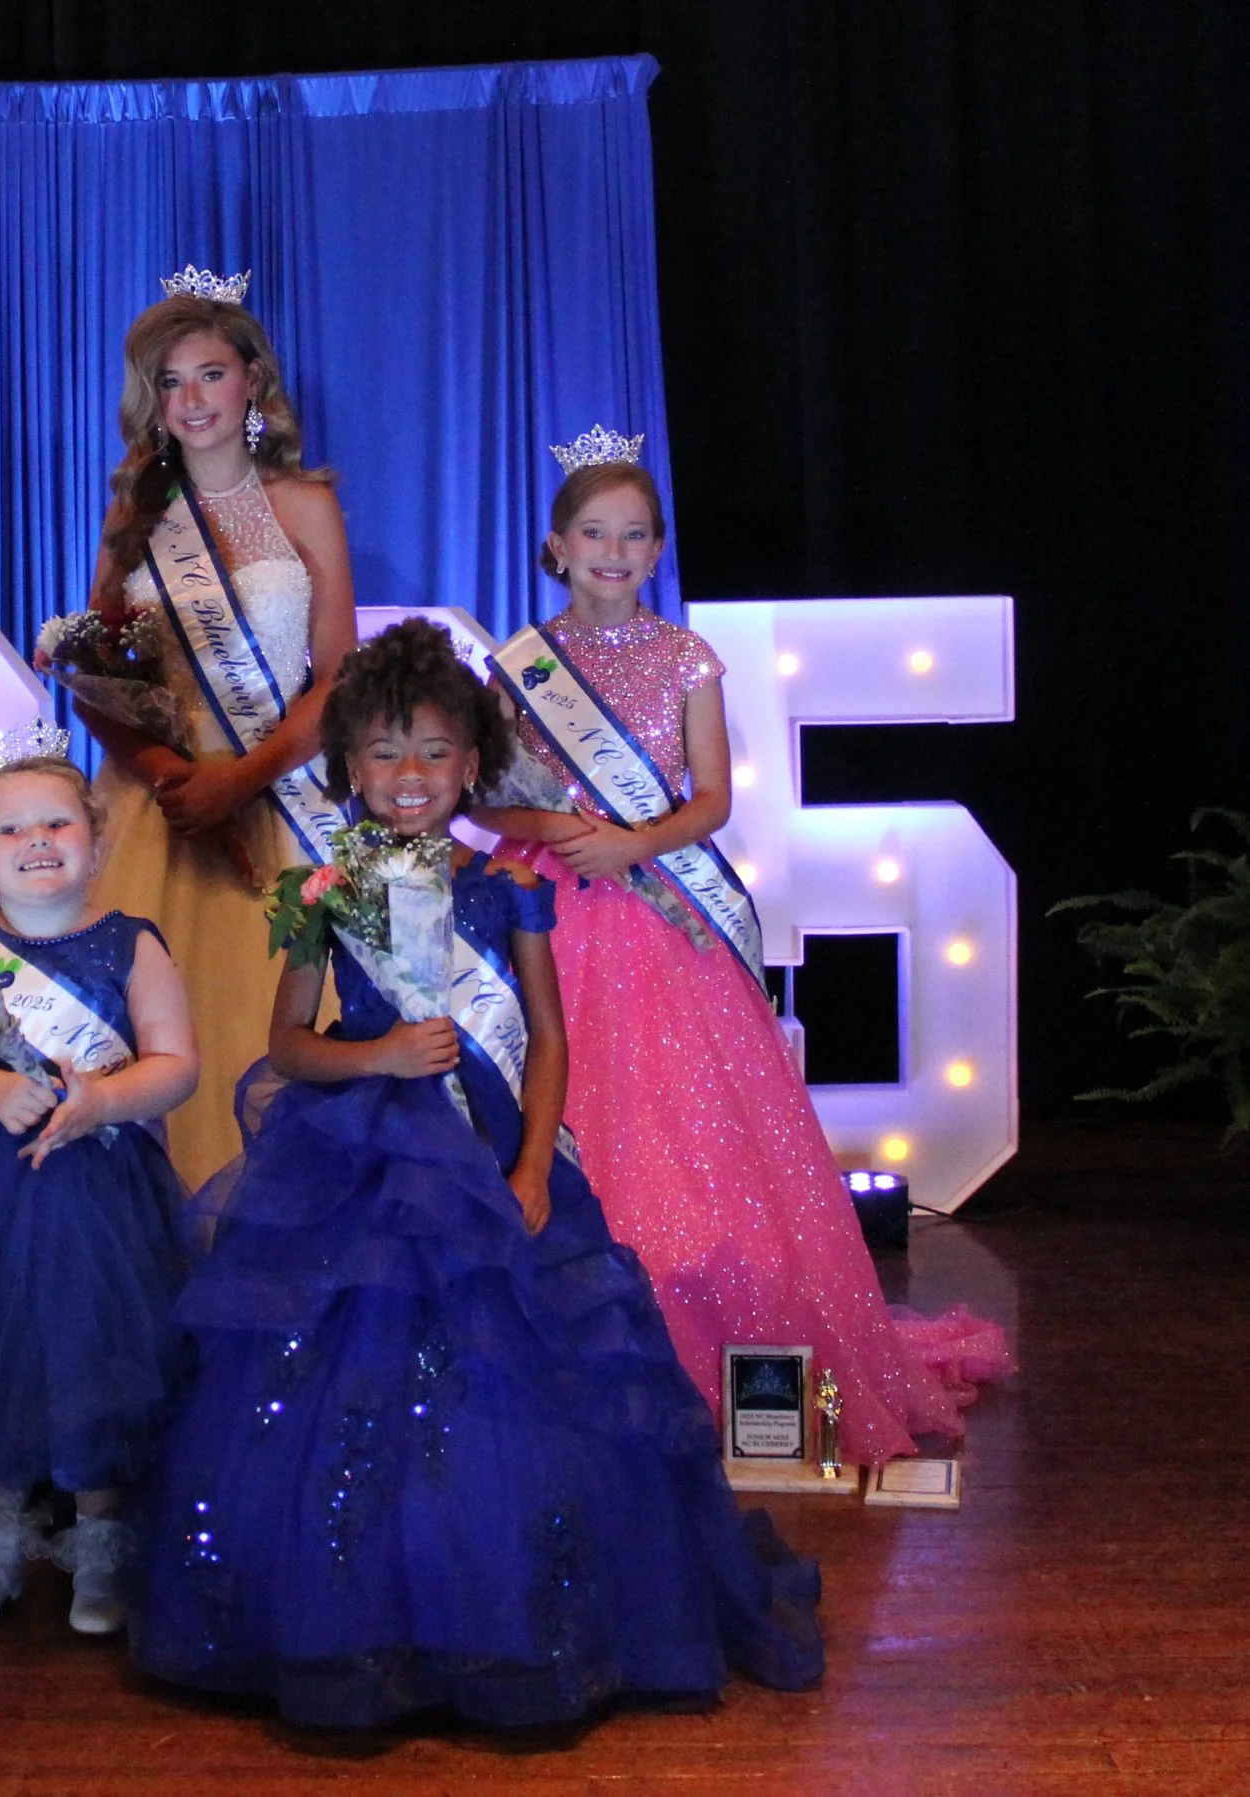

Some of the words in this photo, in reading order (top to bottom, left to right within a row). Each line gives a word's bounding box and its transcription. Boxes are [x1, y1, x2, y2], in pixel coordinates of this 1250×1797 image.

[169, 544, 212, 588] NC
[190, 599, 259, 719] Blueberry
[541, 690, 576, 710] 2025
[568, 721, 623, 765] NC
[9, 993, 56, 1011] 2025
[50, 1021, 114, 1063] NC
